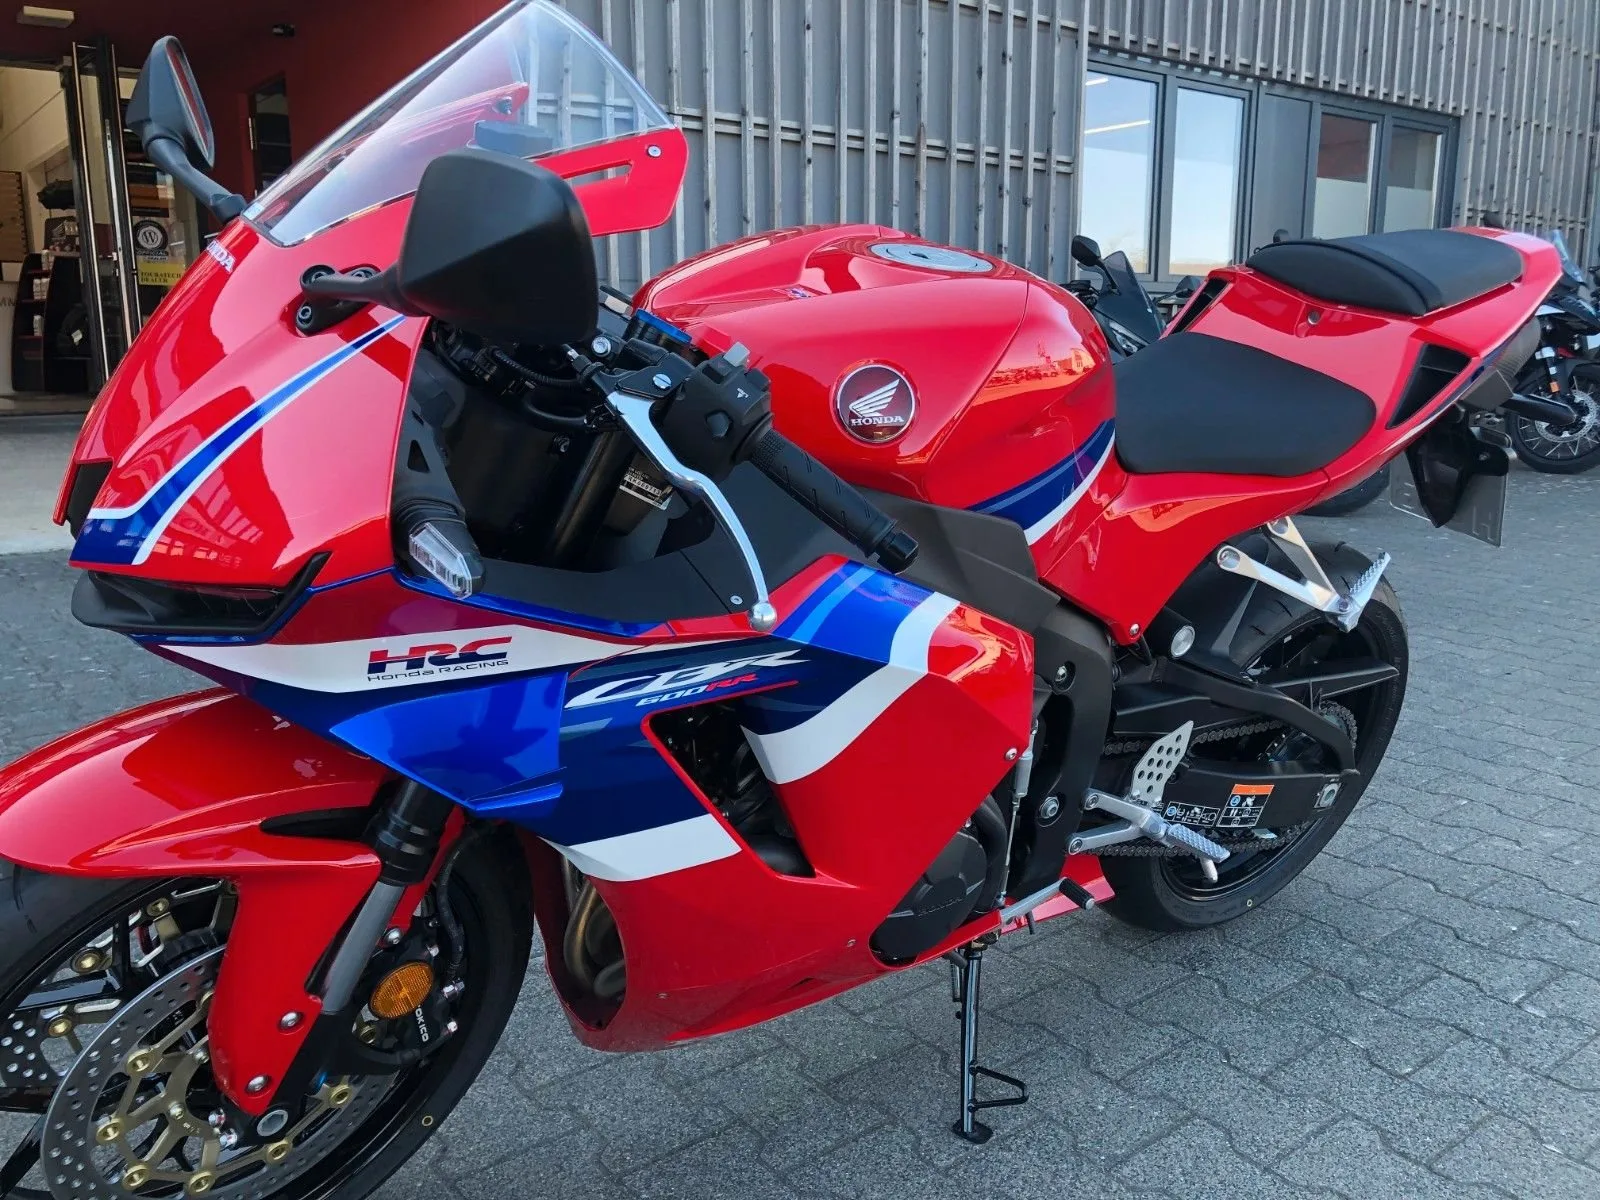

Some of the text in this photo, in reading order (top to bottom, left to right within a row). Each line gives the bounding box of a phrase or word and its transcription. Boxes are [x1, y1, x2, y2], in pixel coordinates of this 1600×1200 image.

[206, 239, 236, 274] ONDA
[851, 415, 905, 427] HONDA
[367, 636, 512, 674] HRC
[367, 659, 509, 682] Honda RACING
[563, 649, 811, 709] CBR
[635, 673, 759, 707] 600RR
[415, 1005, 430, 1043] OKICO
